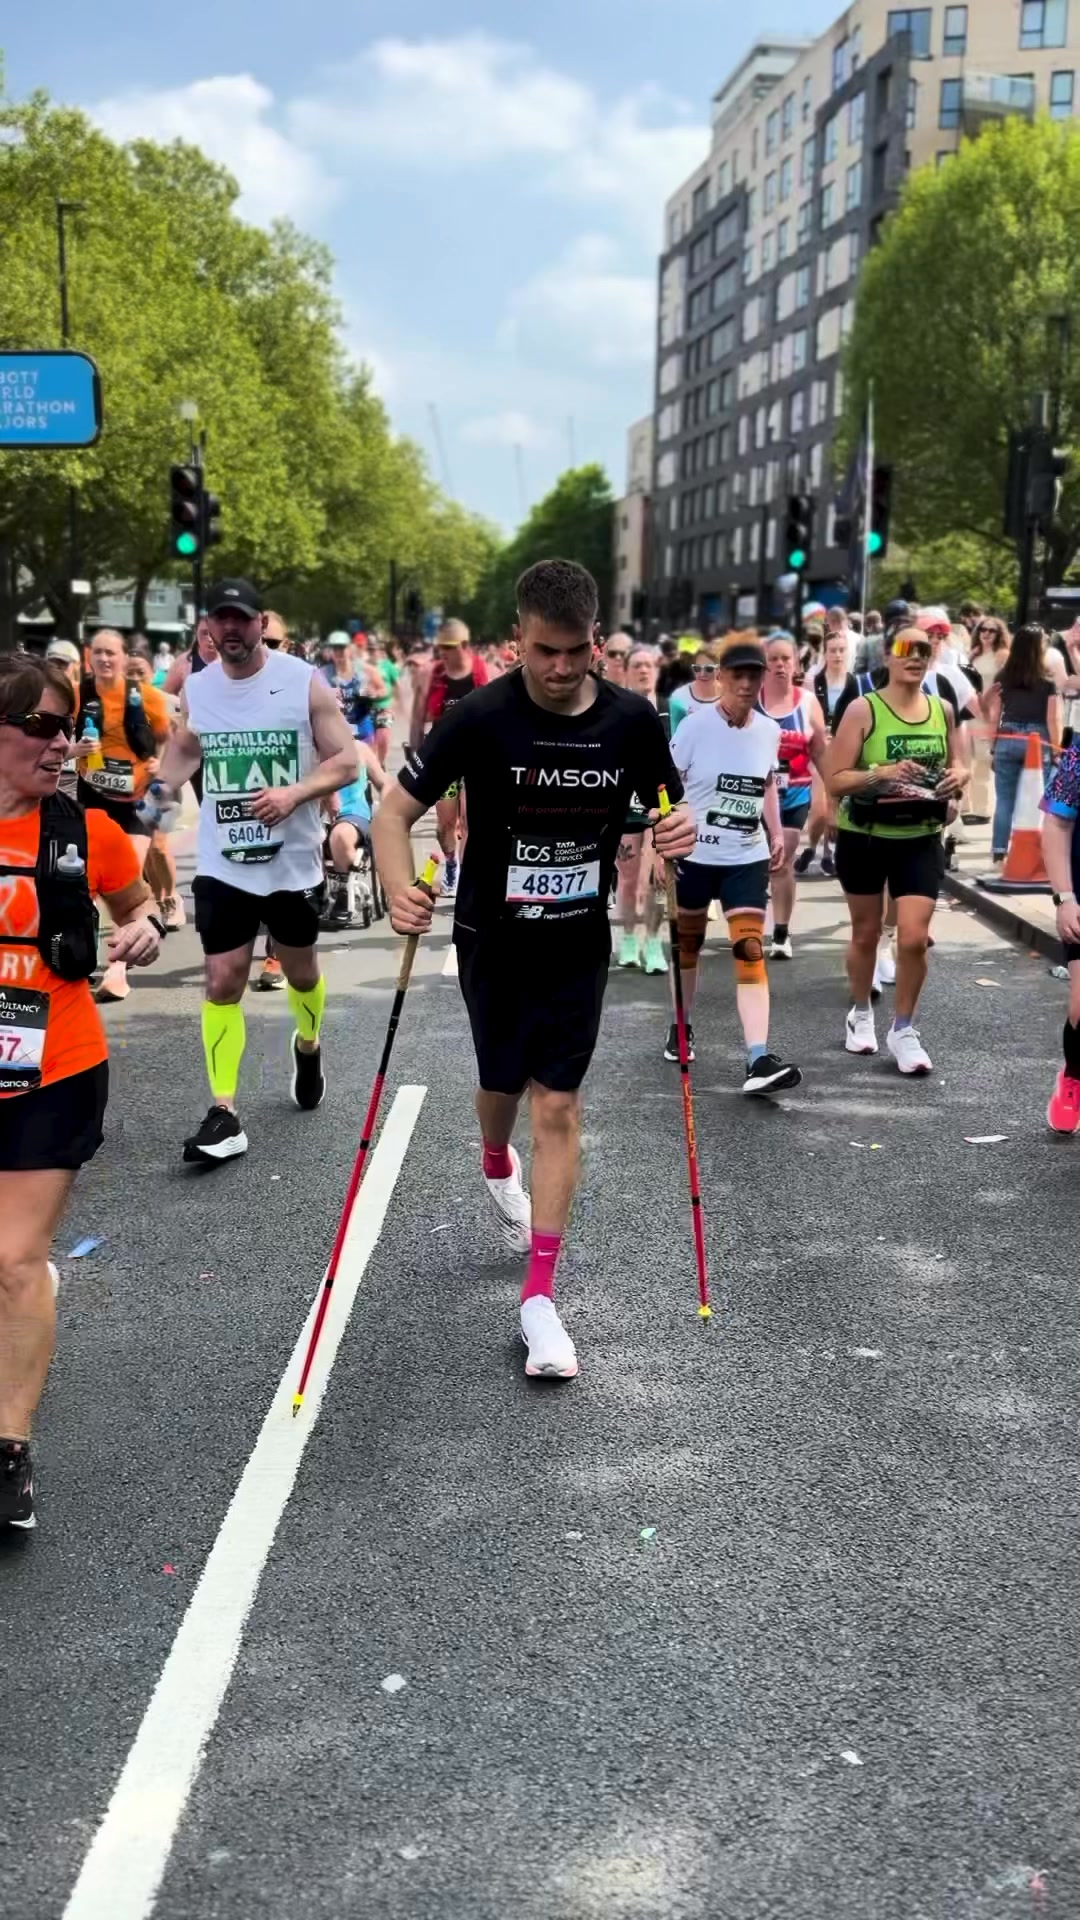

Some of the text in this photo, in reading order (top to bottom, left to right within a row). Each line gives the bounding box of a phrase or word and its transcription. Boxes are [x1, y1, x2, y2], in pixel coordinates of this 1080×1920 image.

[0, 416, 47, 429] JORS
[200, 731, 292, 748] MACMILLAN
[237, 746, 286, 756] SUPPORT
[92, 773, 126, 789] 69132
[207, 759, 296, 791] ALAN
[721, 776, 739, 790] tcs
[218, 804, 240, 819] tcs
[720, 796, 757, 815] 77696
[516, 839, 551, 862] tcs
[554, 843, 598, 855] CONSULTANCY
[555, 841, 576, 849] TATA
[554, 853, 583, 863] SERVICES
[522, 870, 589, 895] 48377
